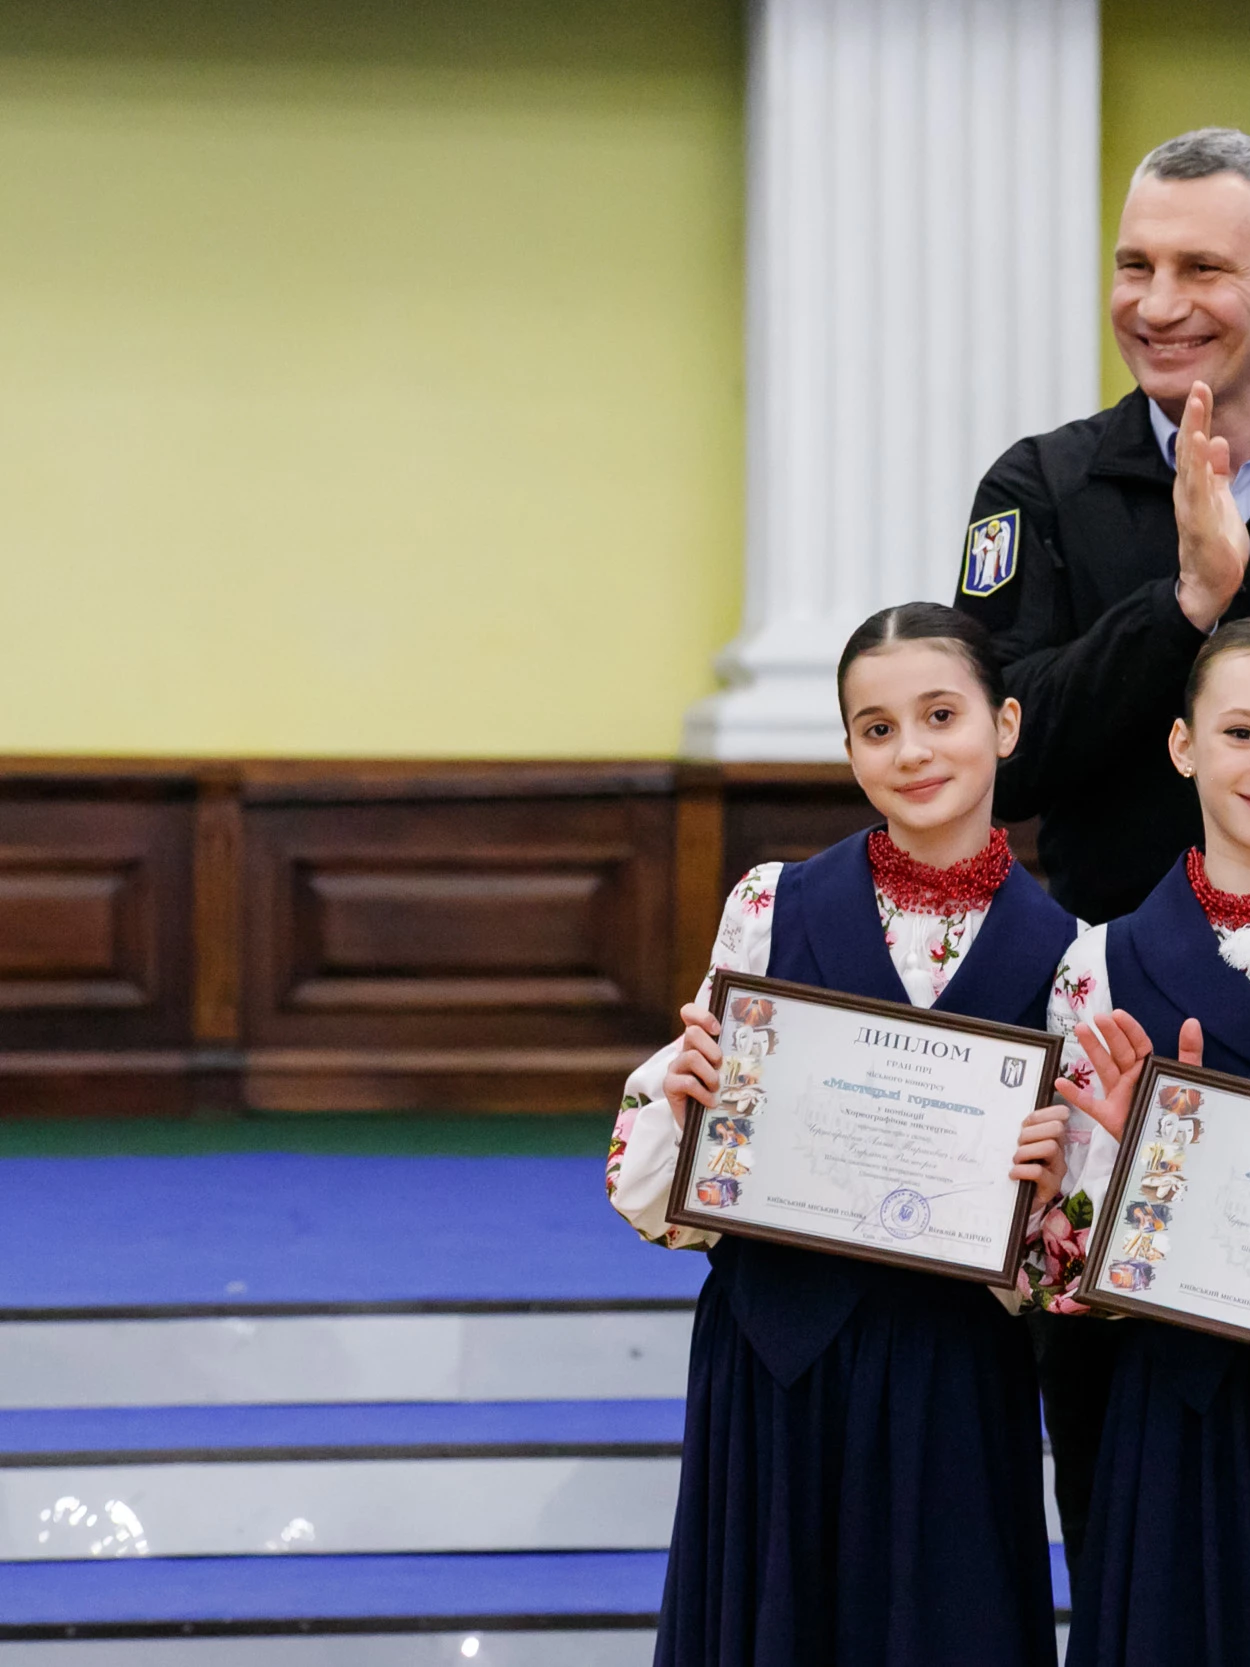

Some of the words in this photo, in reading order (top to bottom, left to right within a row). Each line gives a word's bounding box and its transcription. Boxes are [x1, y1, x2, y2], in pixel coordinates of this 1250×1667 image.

[854, 1027, 972, 1062] ДИПЛОМ
[886, 1060, 911, 1071] ГРАН
[915, 1065, 932, 1075] ПРІ
[905, 1079, 945, 1092] конкурсу
